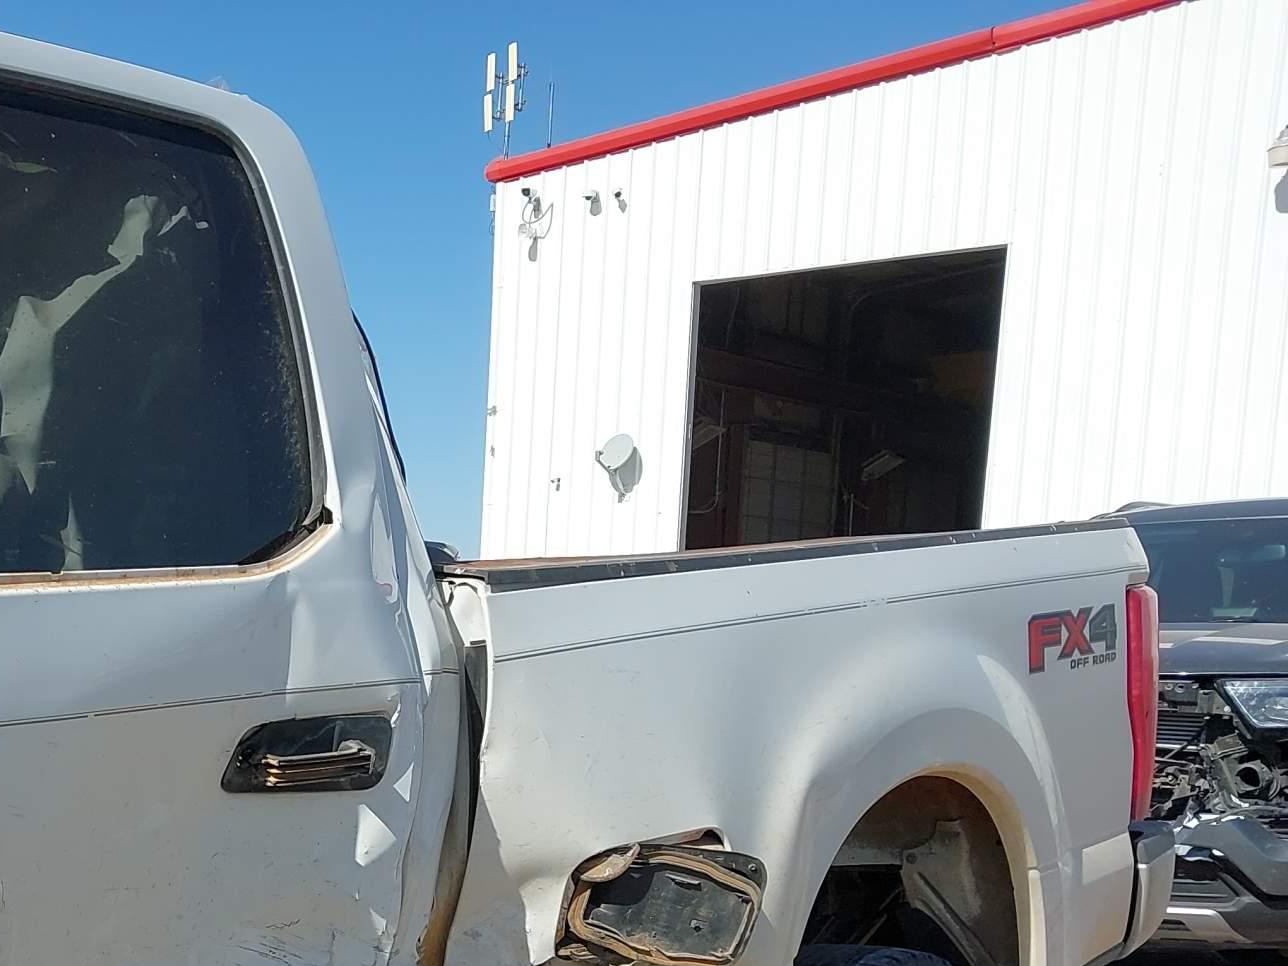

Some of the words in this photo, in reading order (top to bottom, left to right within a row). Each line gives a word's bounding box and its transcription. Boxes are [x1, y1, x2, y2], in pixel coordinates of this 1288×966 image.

[1028, 603, 1117, 674] FX4
[1070, 656, 1090, 670] OFF
[1092, 652, 1117, 666] ROAD
